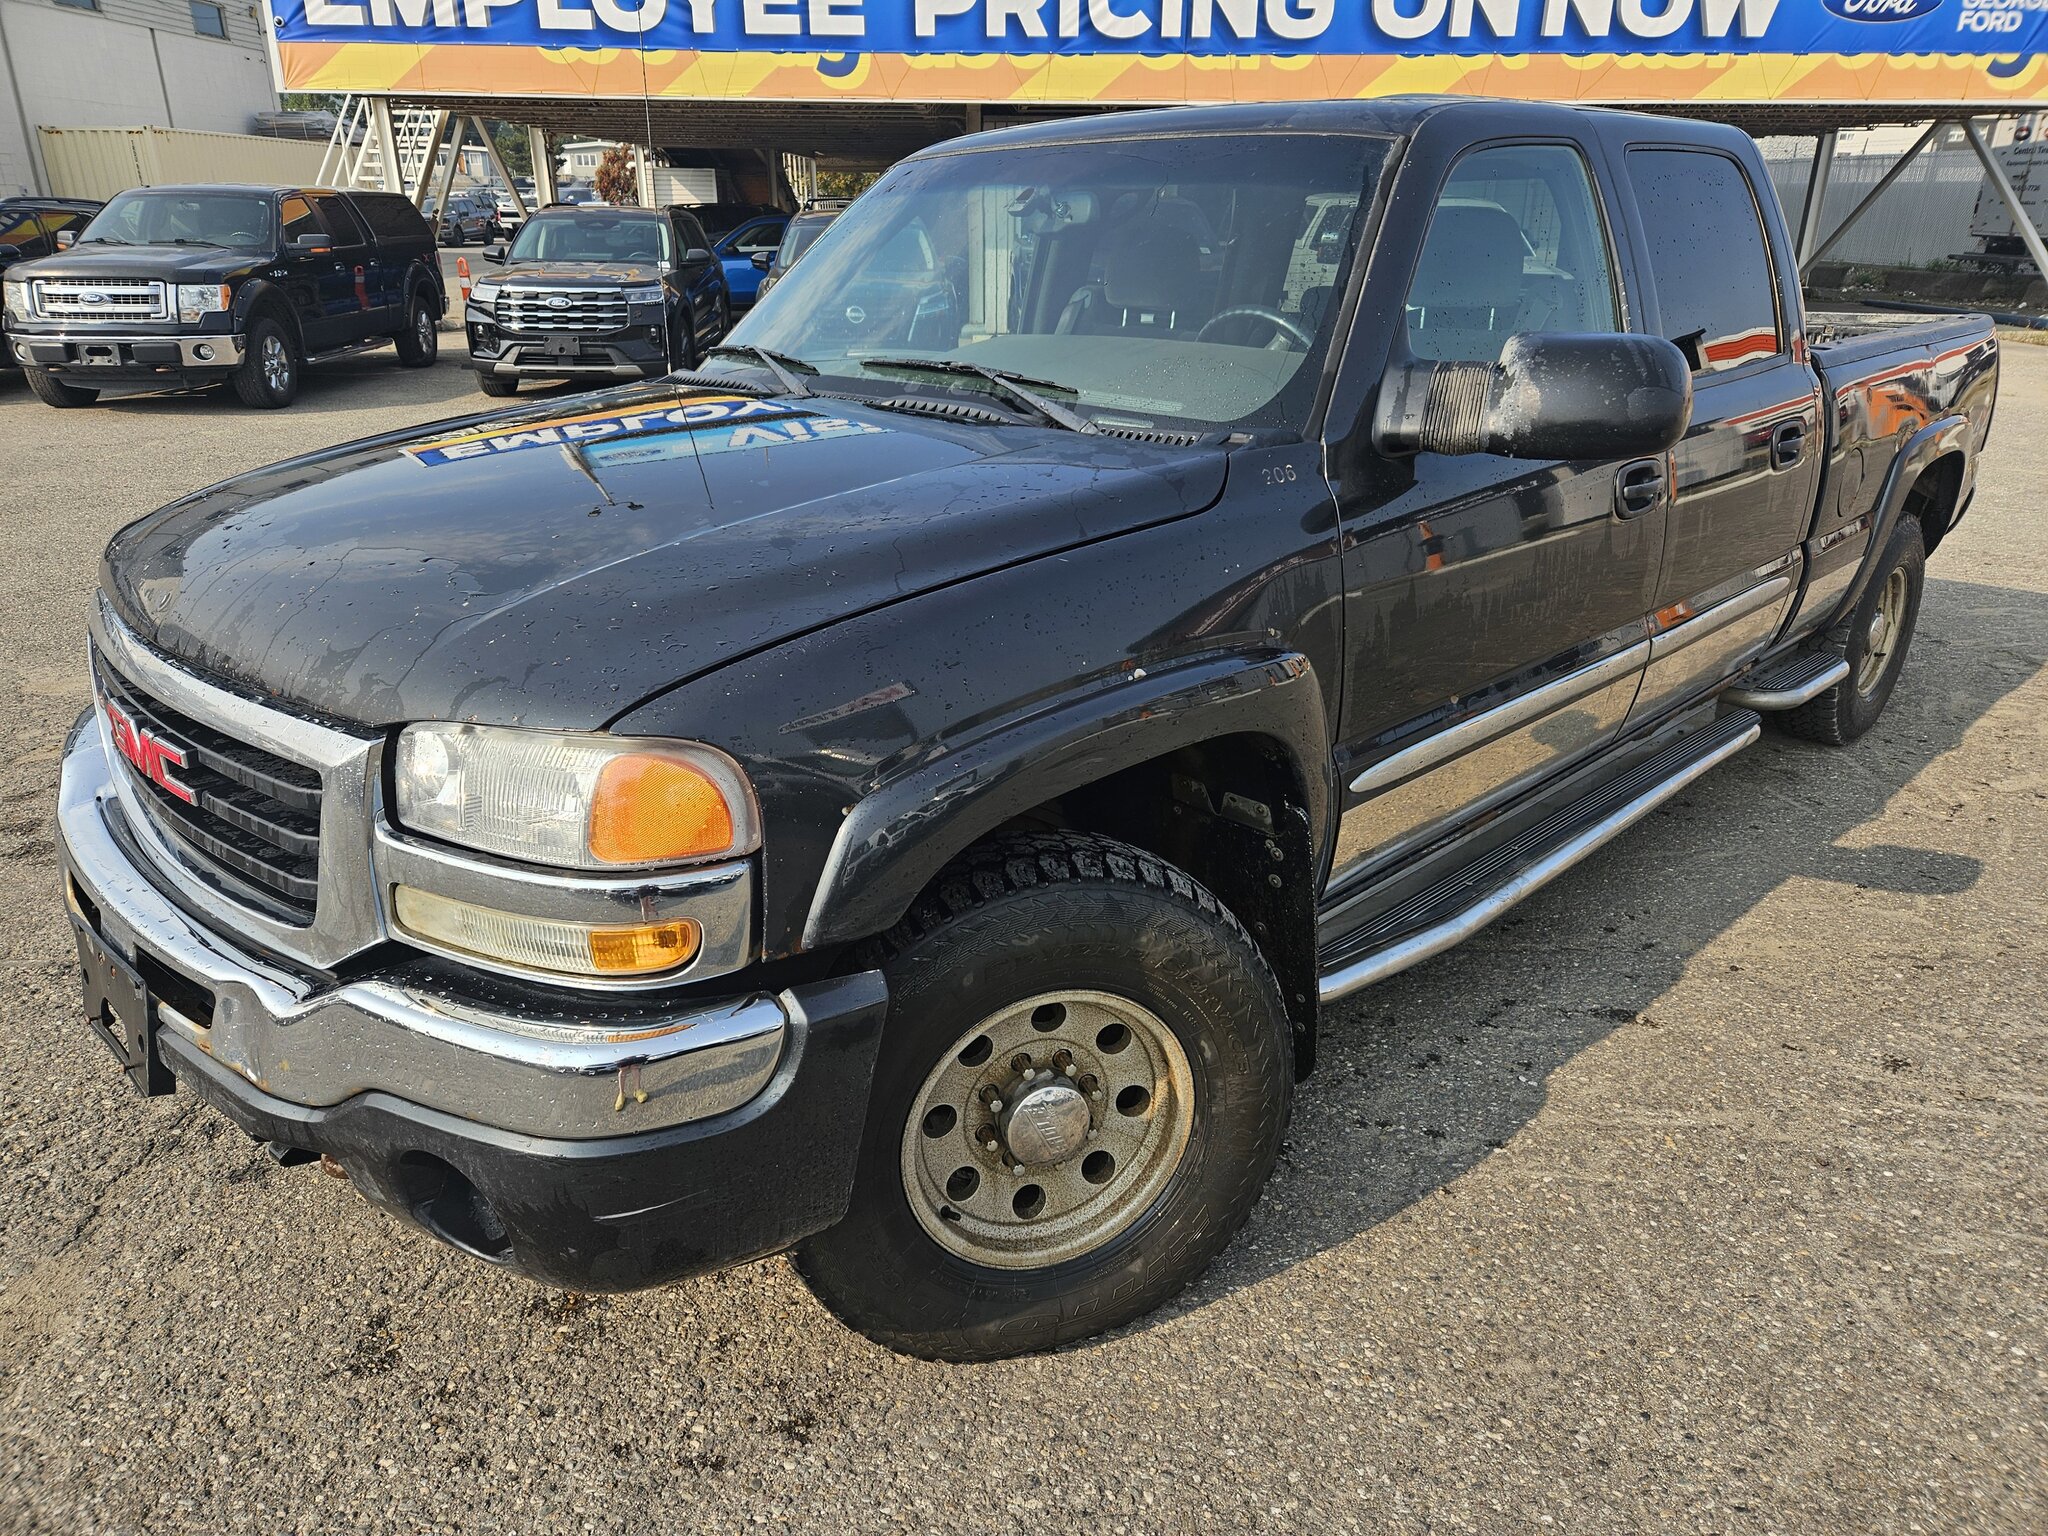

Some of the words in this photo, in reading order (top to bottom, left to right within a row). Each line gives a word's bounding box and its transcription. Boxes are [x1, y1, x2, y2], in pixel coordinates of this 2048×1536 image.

[915, 0, 1335, 38] PRICING
[1372, 0, 1517, 38] ON
[1541, 0, 1780, 38] NOW
[1956, 11, 2023, 32] FORD
[106, 698, 199, 808] GMC
